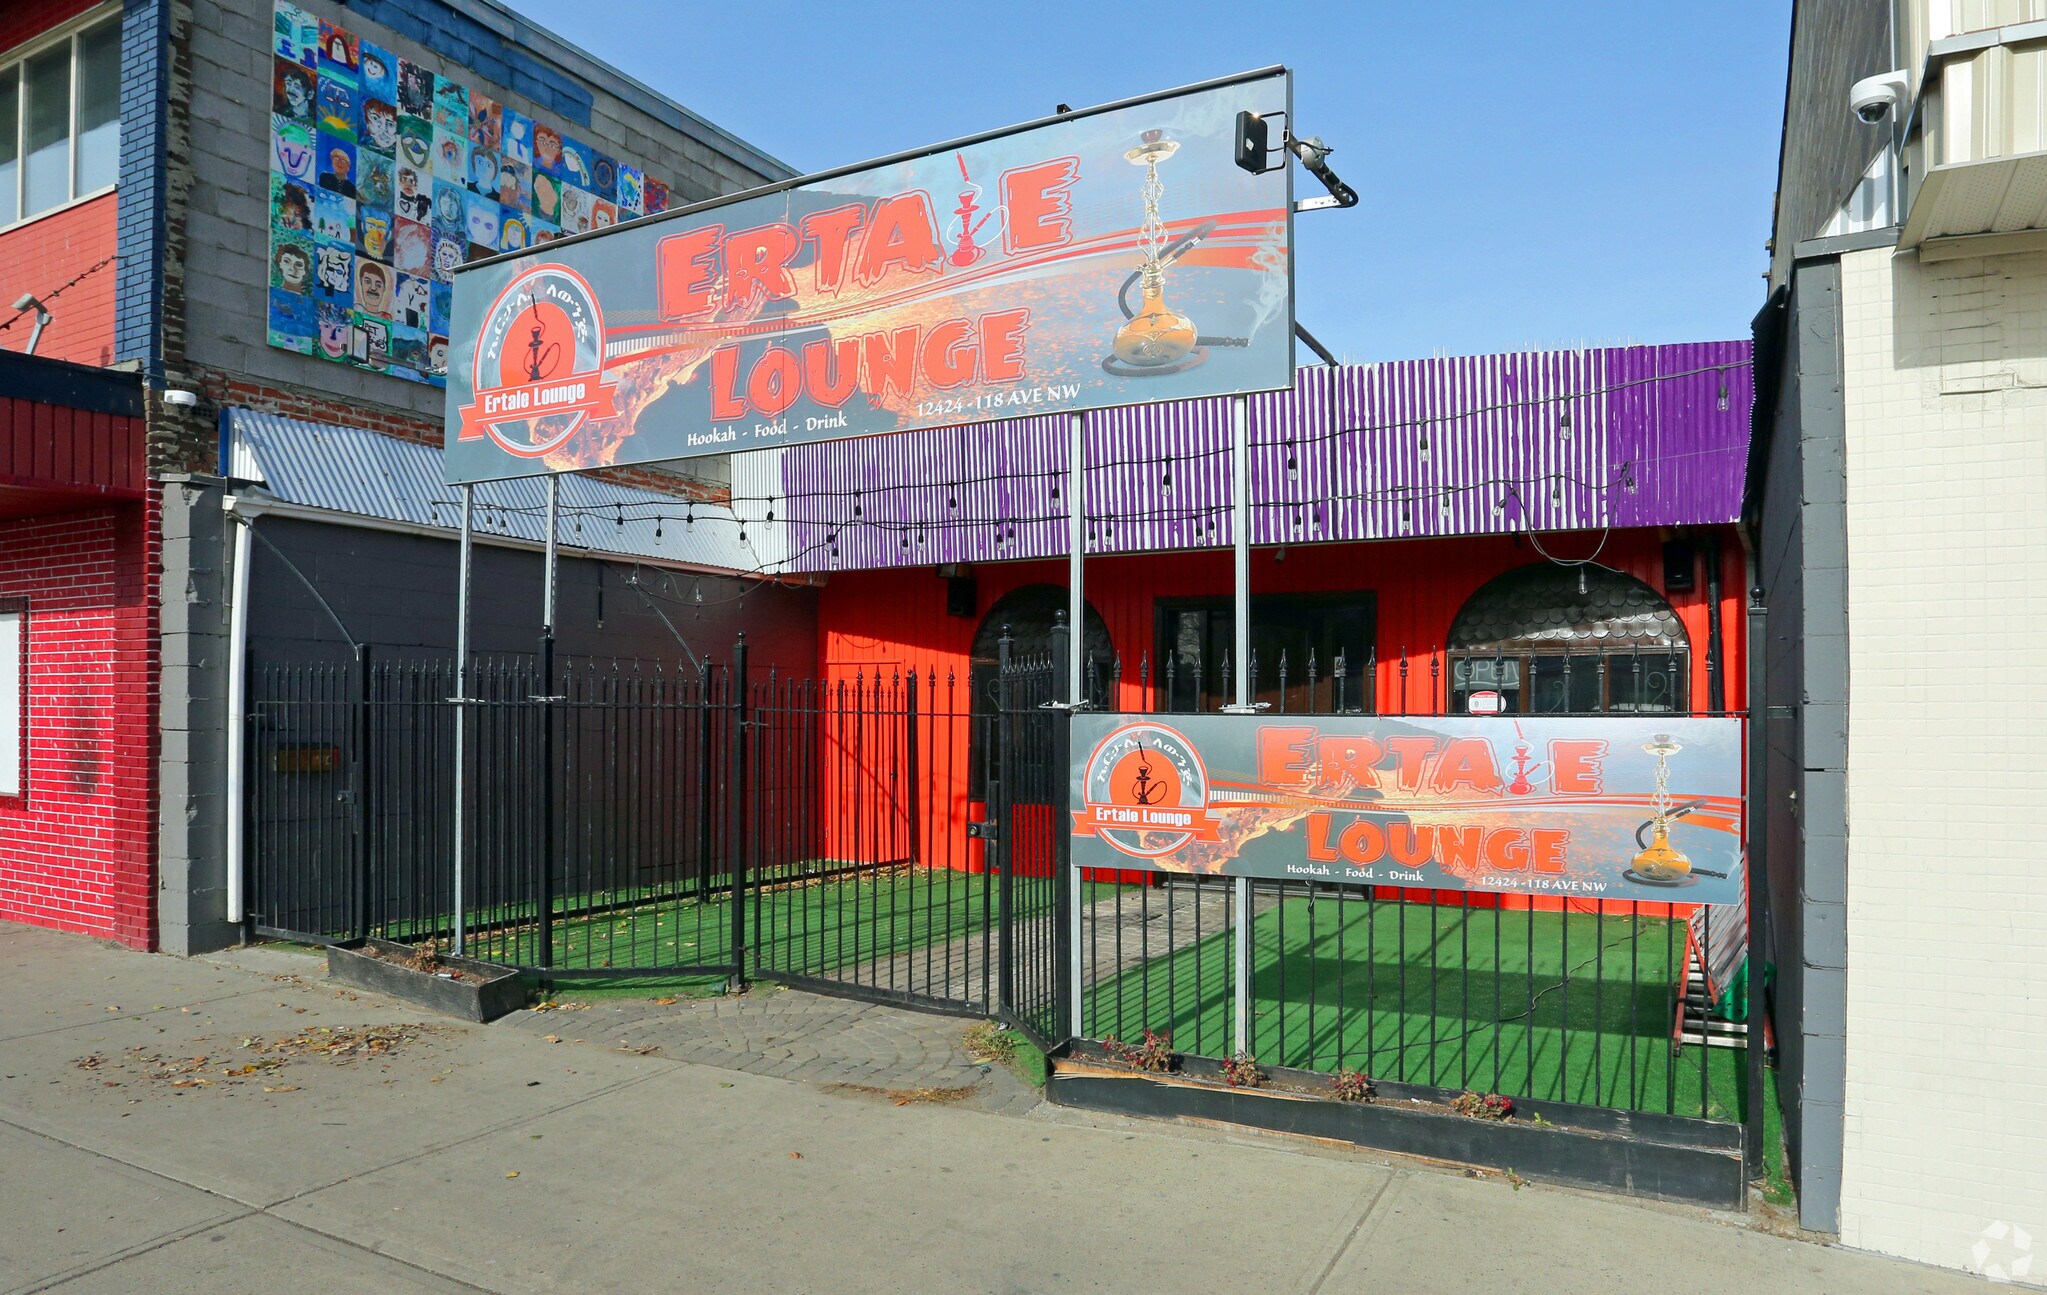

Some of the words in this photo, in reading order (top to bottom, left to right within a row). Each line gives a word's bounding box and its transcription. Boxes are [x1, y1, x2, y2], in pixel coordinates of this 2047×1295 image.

[709, 307, 1032, 422] LOUNGE
[484, 390, 530, 414] Ertale
[533, 382, 586, 406] Lounge
[916, 397, 963, 417] 12424
[1007, 387, 1043, 406] AVE
[1047, 383, 1081, 401] NW
[687, 425, 737, 447] Hookah
[755, 418, 787, 438] Food
[805, 410, 848, 431] Drink
[1096, 807, 1139, 823] Ertale
[1142, 809, 1192, 827] Lounge
[1305, 811, 1571, 875] LOUNGE
[1286, 864, 1330, 876] Hookah
[1345, 868, 1373, 879] Food
[1389, 870, 1424, 882] Drink
[1481, 876, 1517, 888] 12424
[1552, 880, 1579, 890] AVE
[1582, 881, 1608, 892] NW
